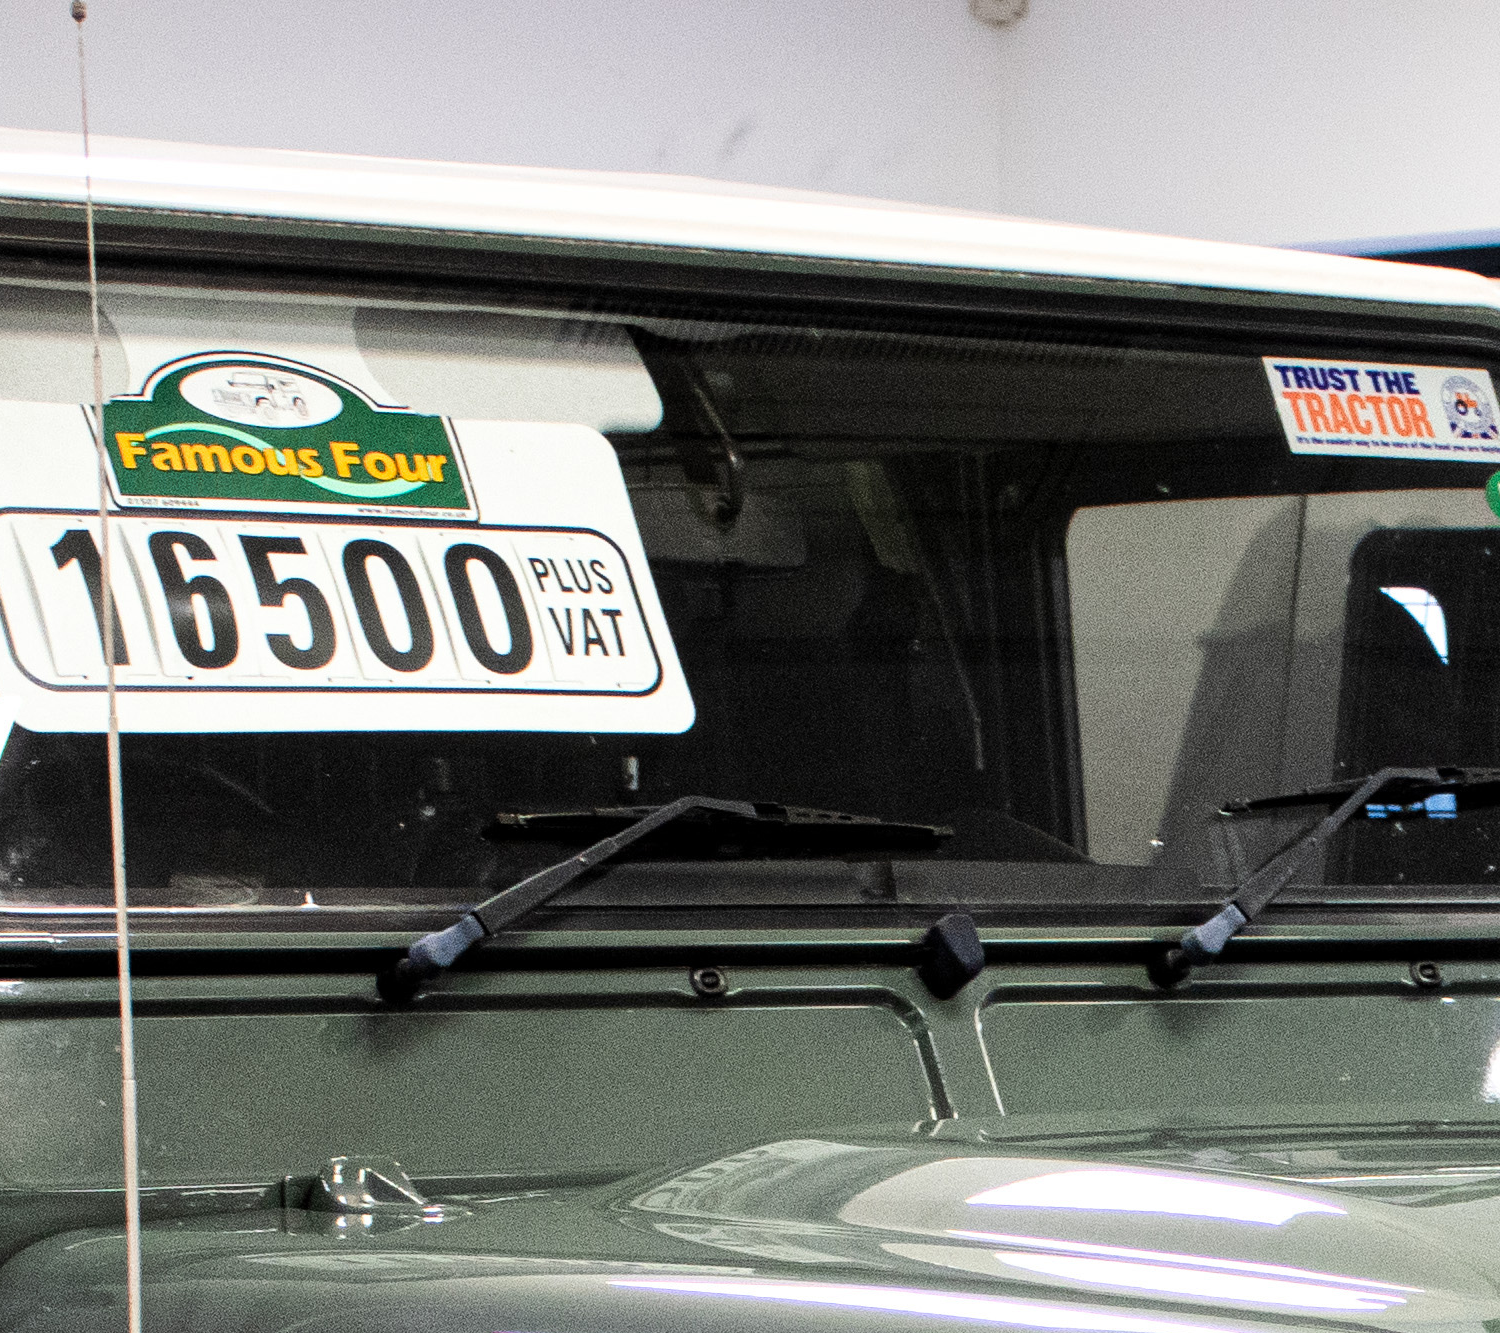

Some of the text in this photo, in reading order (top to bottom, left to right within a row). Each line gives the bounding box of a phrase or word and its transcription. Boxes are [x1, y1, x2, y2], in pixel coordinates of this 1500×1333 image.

[1275, 365, 1418, 394] TRUST THE
[1283, 392, 1436, 438] TRACTOR
[115, 432, 448, 485] Famous Four
[529, 557, 614, 594] PLUS
[50, 527, 534, 676] 16500
[554, 609, 631, 660] VAT
